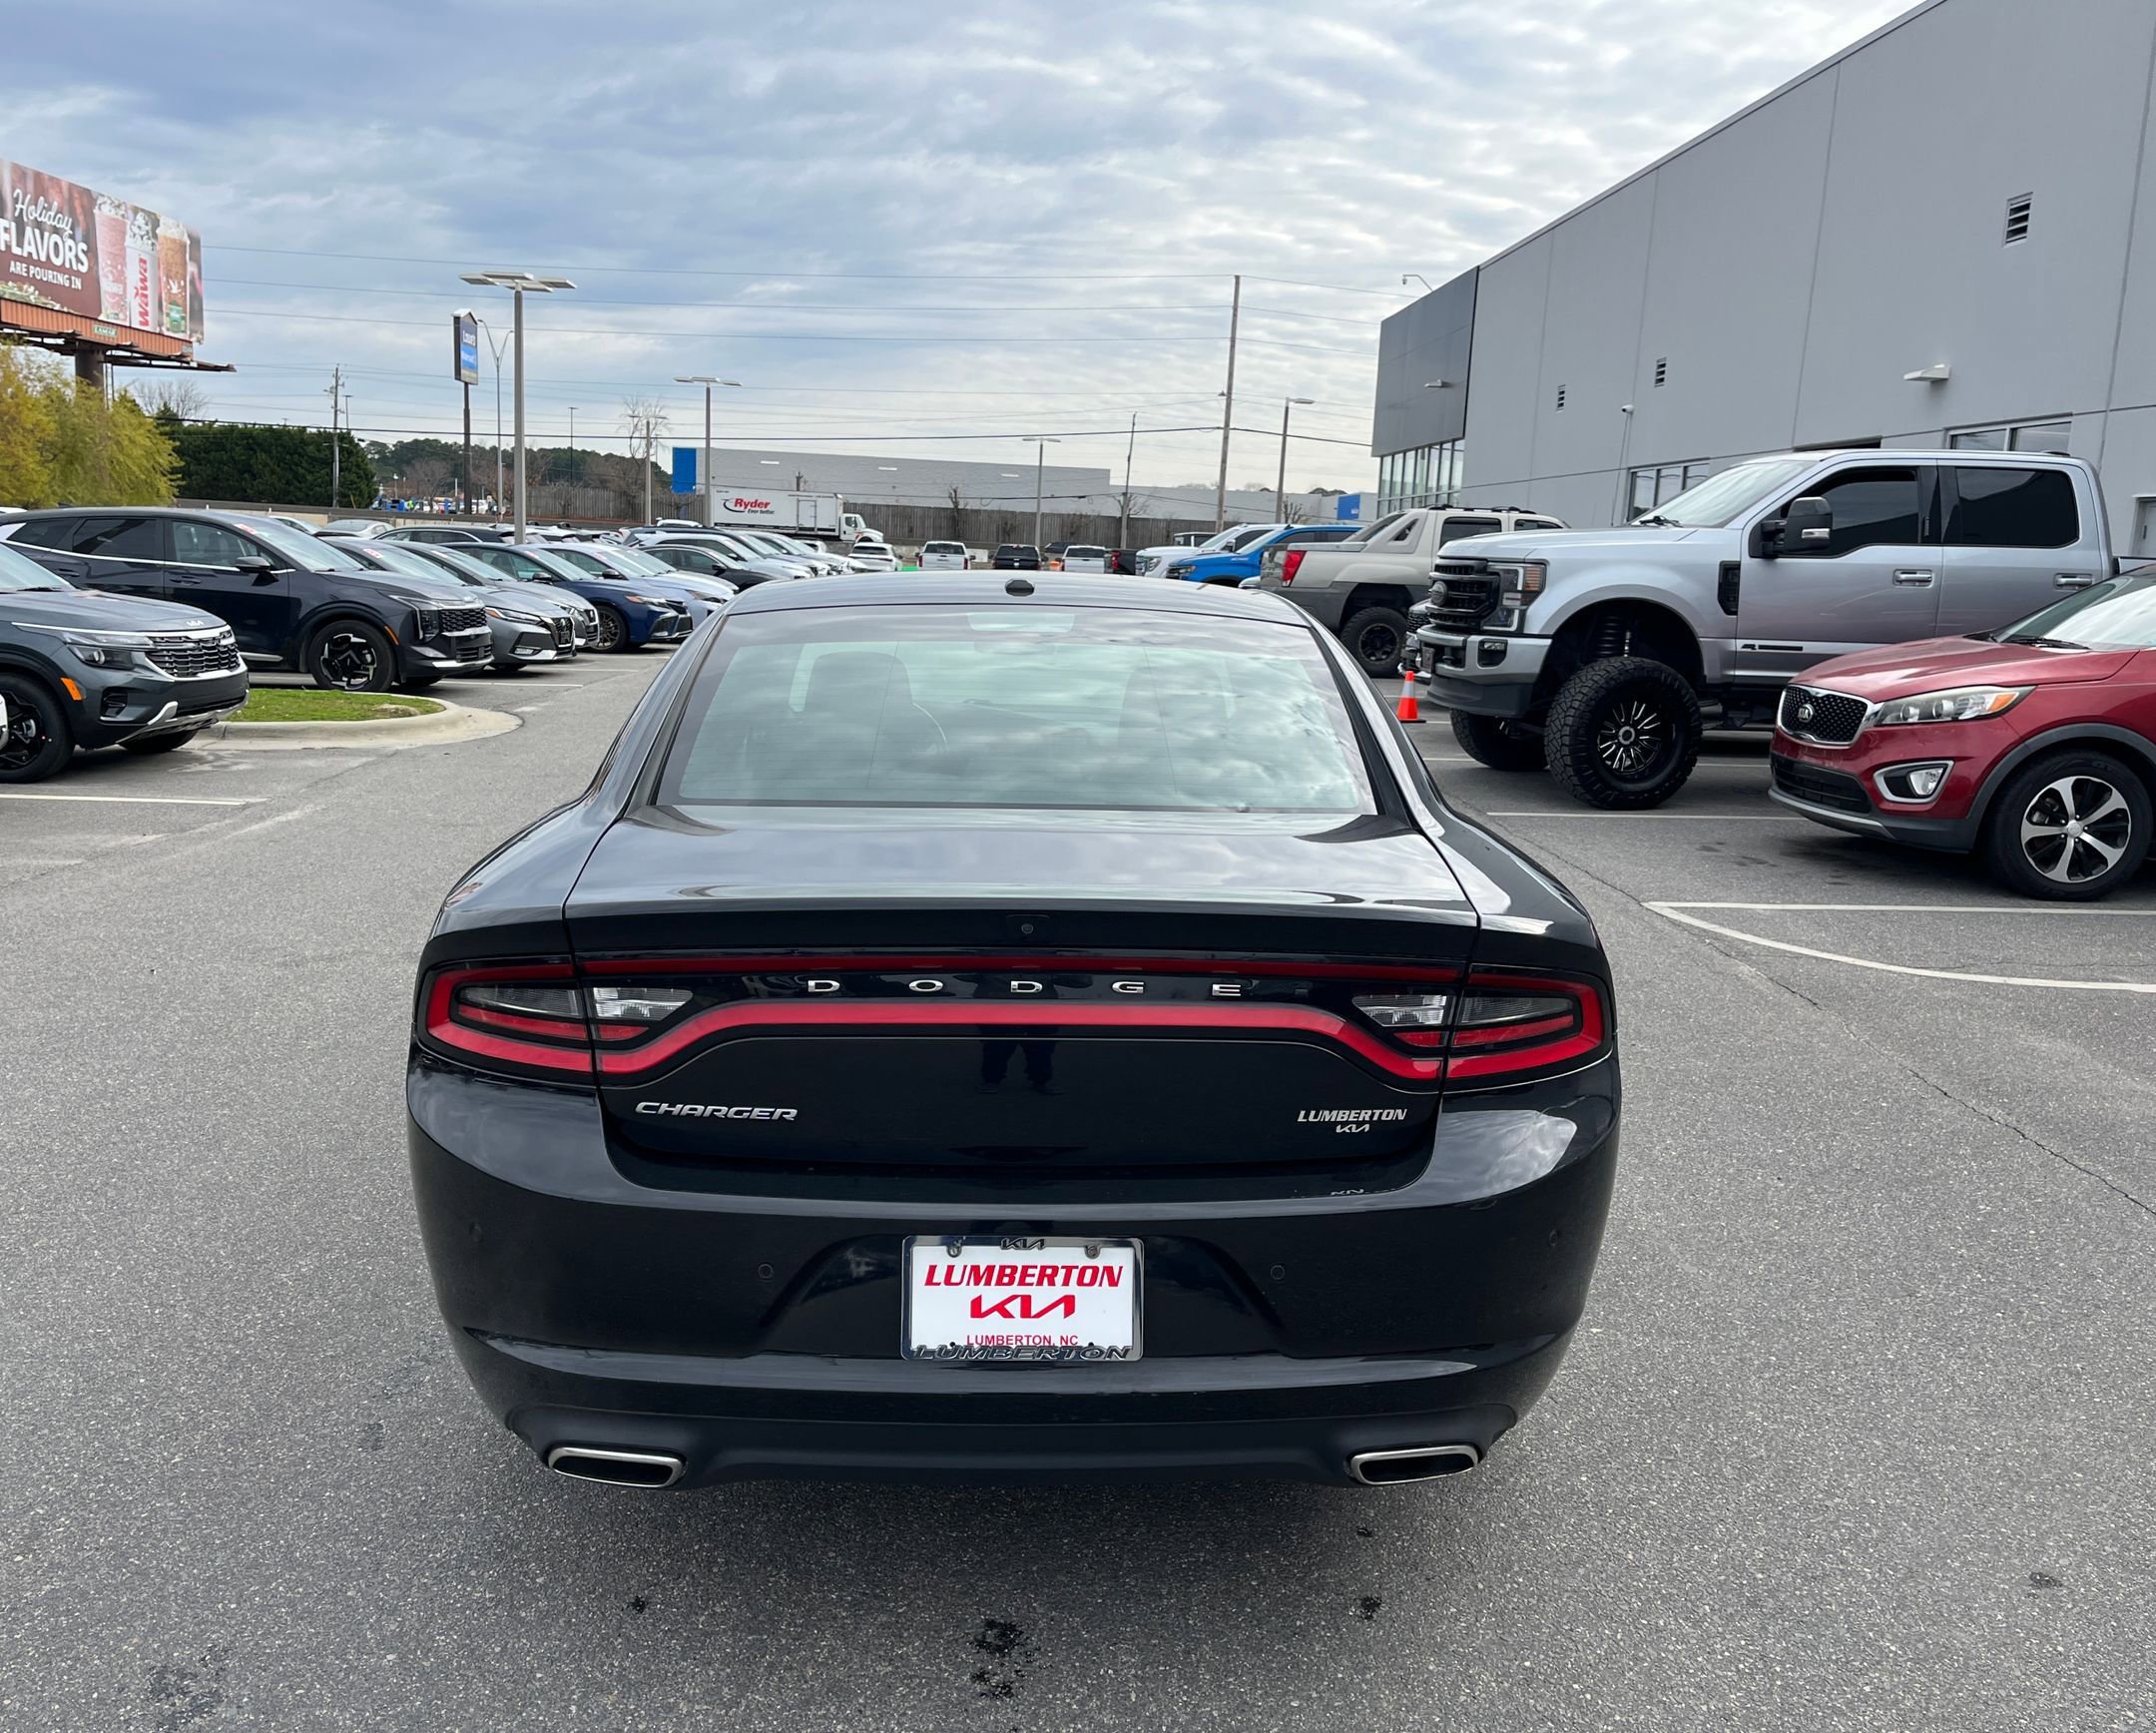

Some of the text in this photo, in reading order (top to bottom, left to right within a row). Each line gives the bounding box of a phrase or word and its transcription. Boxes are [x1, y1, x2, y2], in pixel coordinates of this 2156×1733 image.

[13, 189, 73, 241] Holiday
[0, 218, 89, 274] FLAVORS
[9, 260, 82, 289] ARE POURING IN
[734, 498, 771, 510] Ryder
[808, 979, 1242, 997] DODGE
[635, 1101, 798, 1121] CHARGER
[1298, 1108, 1407, 1122] LUMBERTON
[1336, 1123, 1370, 1133] KIA
[1001, 1237, 1046, 1251] KIA
[924, 1264, 1124, 1288] LUMBERTON
[970, 1294, 1076, 1320] KIA
[1060, 1334, 1079, 1347] NC
[911, 1344, 1133, 1361] LUMBERTON
